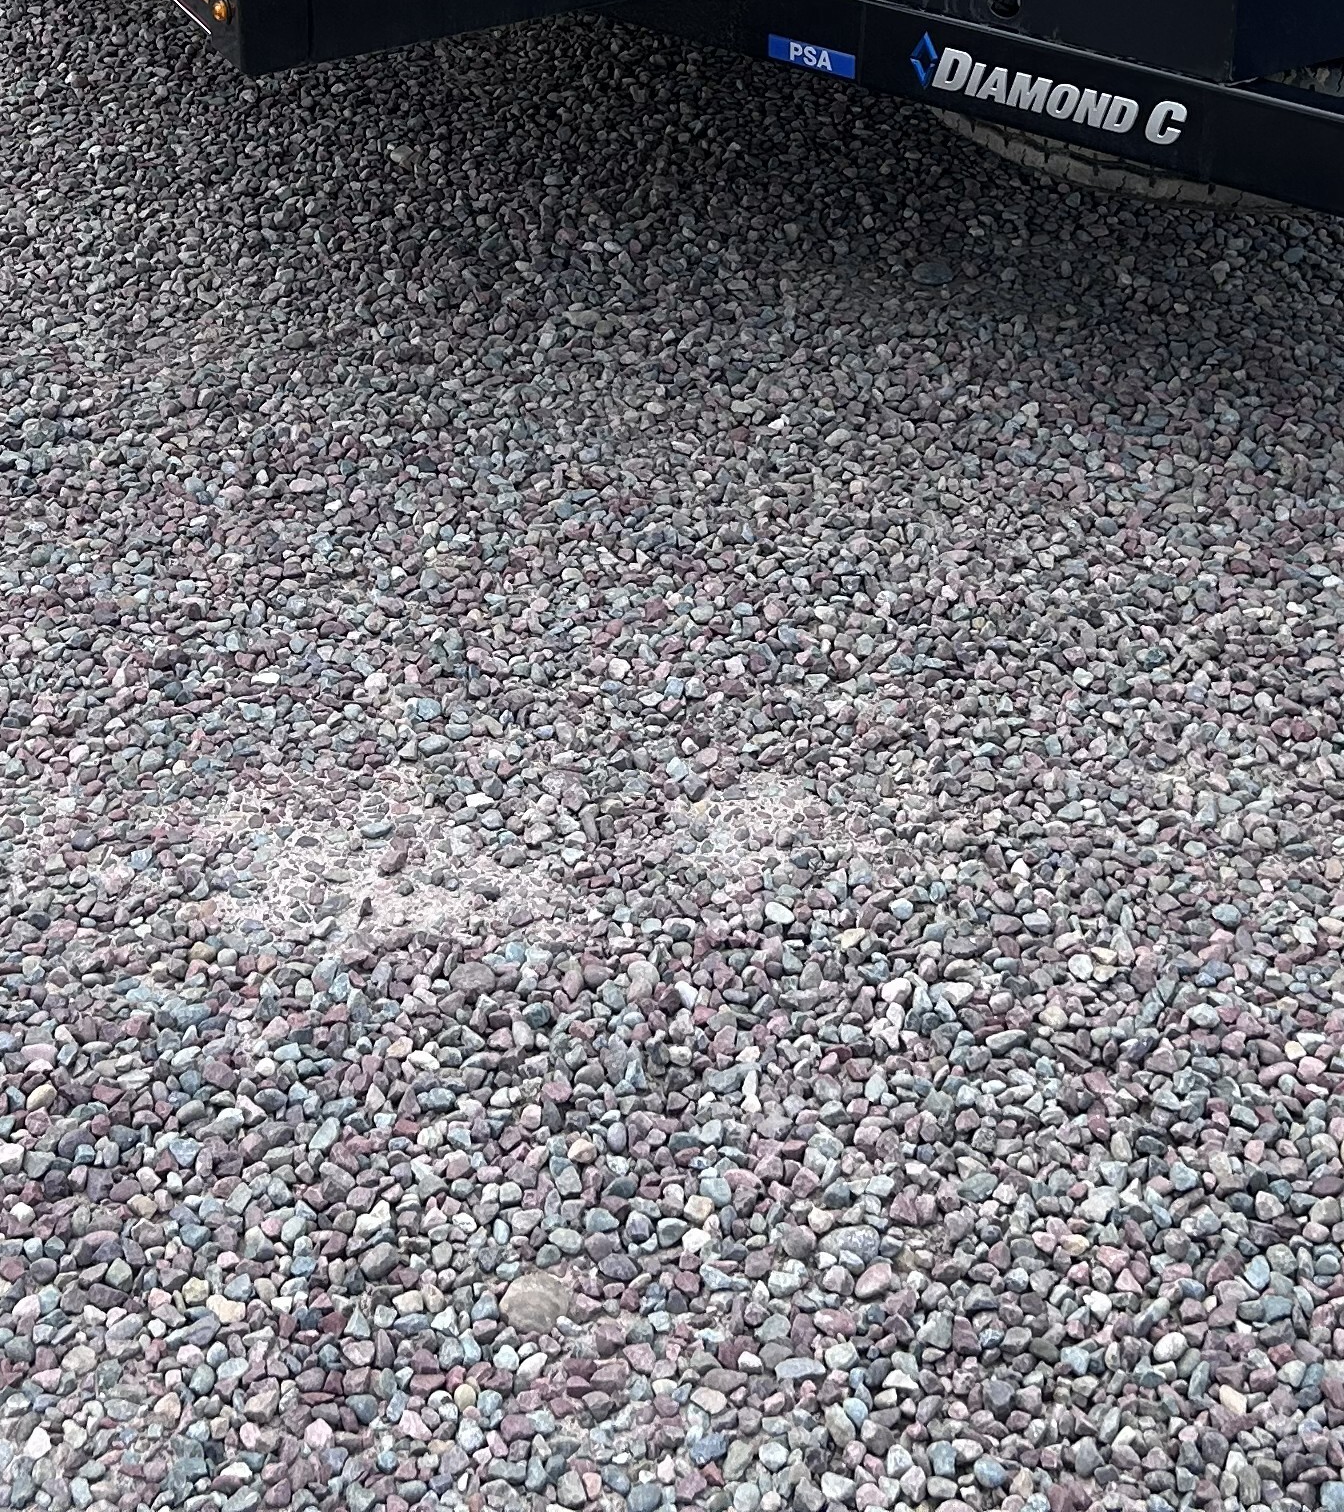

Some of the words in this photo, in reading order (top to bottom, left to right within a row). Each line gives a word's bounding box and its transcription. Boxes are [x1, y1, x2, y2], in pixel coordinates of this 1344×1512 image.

[788, 42, 833, 72] PSA
[931, 47, 1140, 134] DIAMOND
[1144, 100, 1188, 145] C
